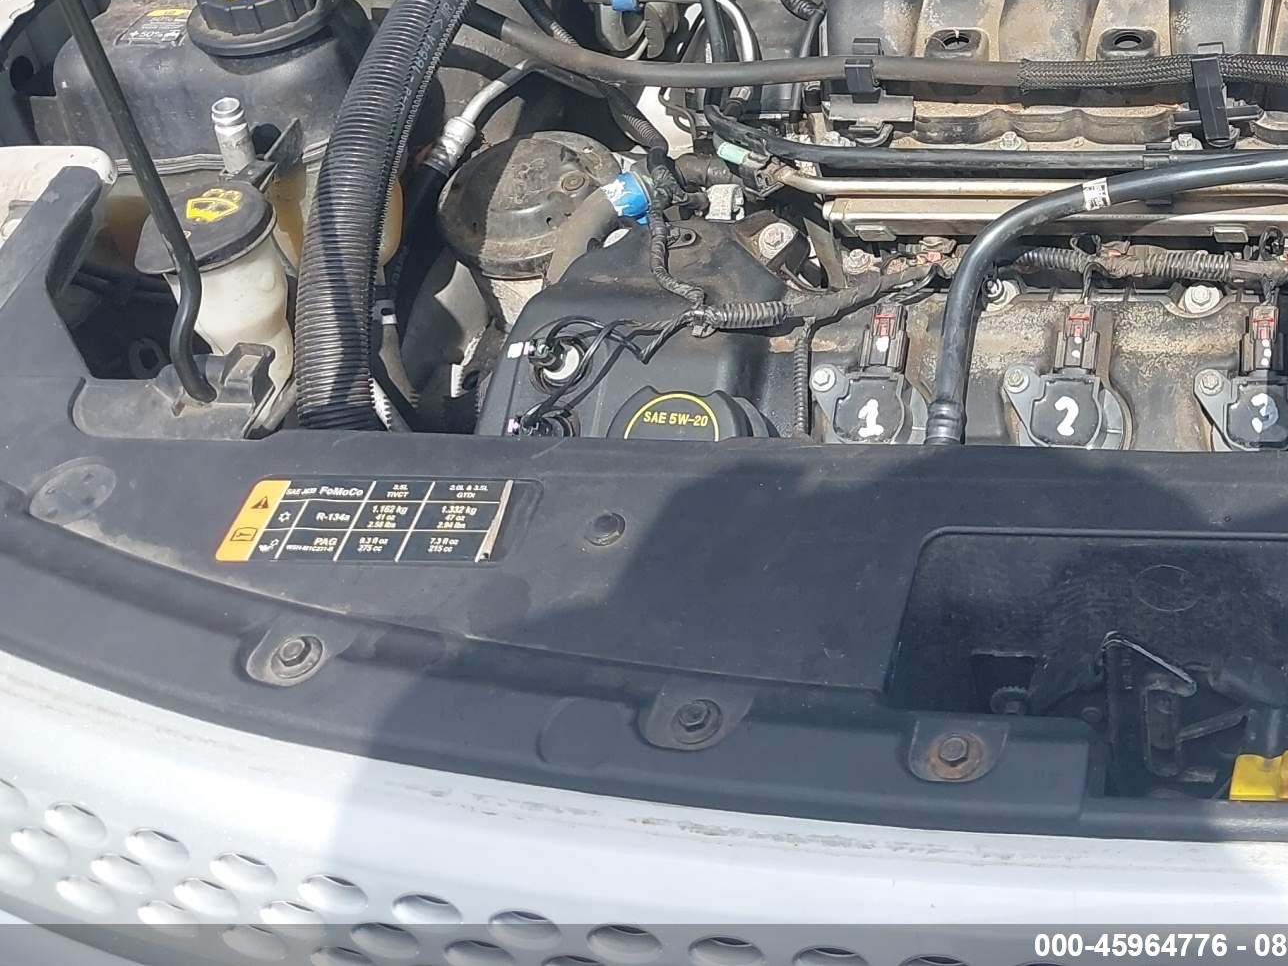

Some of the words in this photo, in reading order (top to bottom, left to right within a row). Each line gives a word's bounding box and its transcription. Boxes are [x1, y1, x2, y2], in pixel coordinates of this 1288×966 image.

[858, 398, 883, 435] 1
[1054, 396, 1080, 435] 2
[1251, 393, 1280, 433] 3
[643, 411, 667, 424] SAE
[669, 413, 709, 427] 5W-20
[319, 486, 364, 496] FoMoCo
[372, 505, 394, 513] 1.162
[396, 506, 408, 515] kg
[465, 506, 477, 515] kg
[316, 512, 350, 521] R-134a
[357, 544, 372, 552] 275
